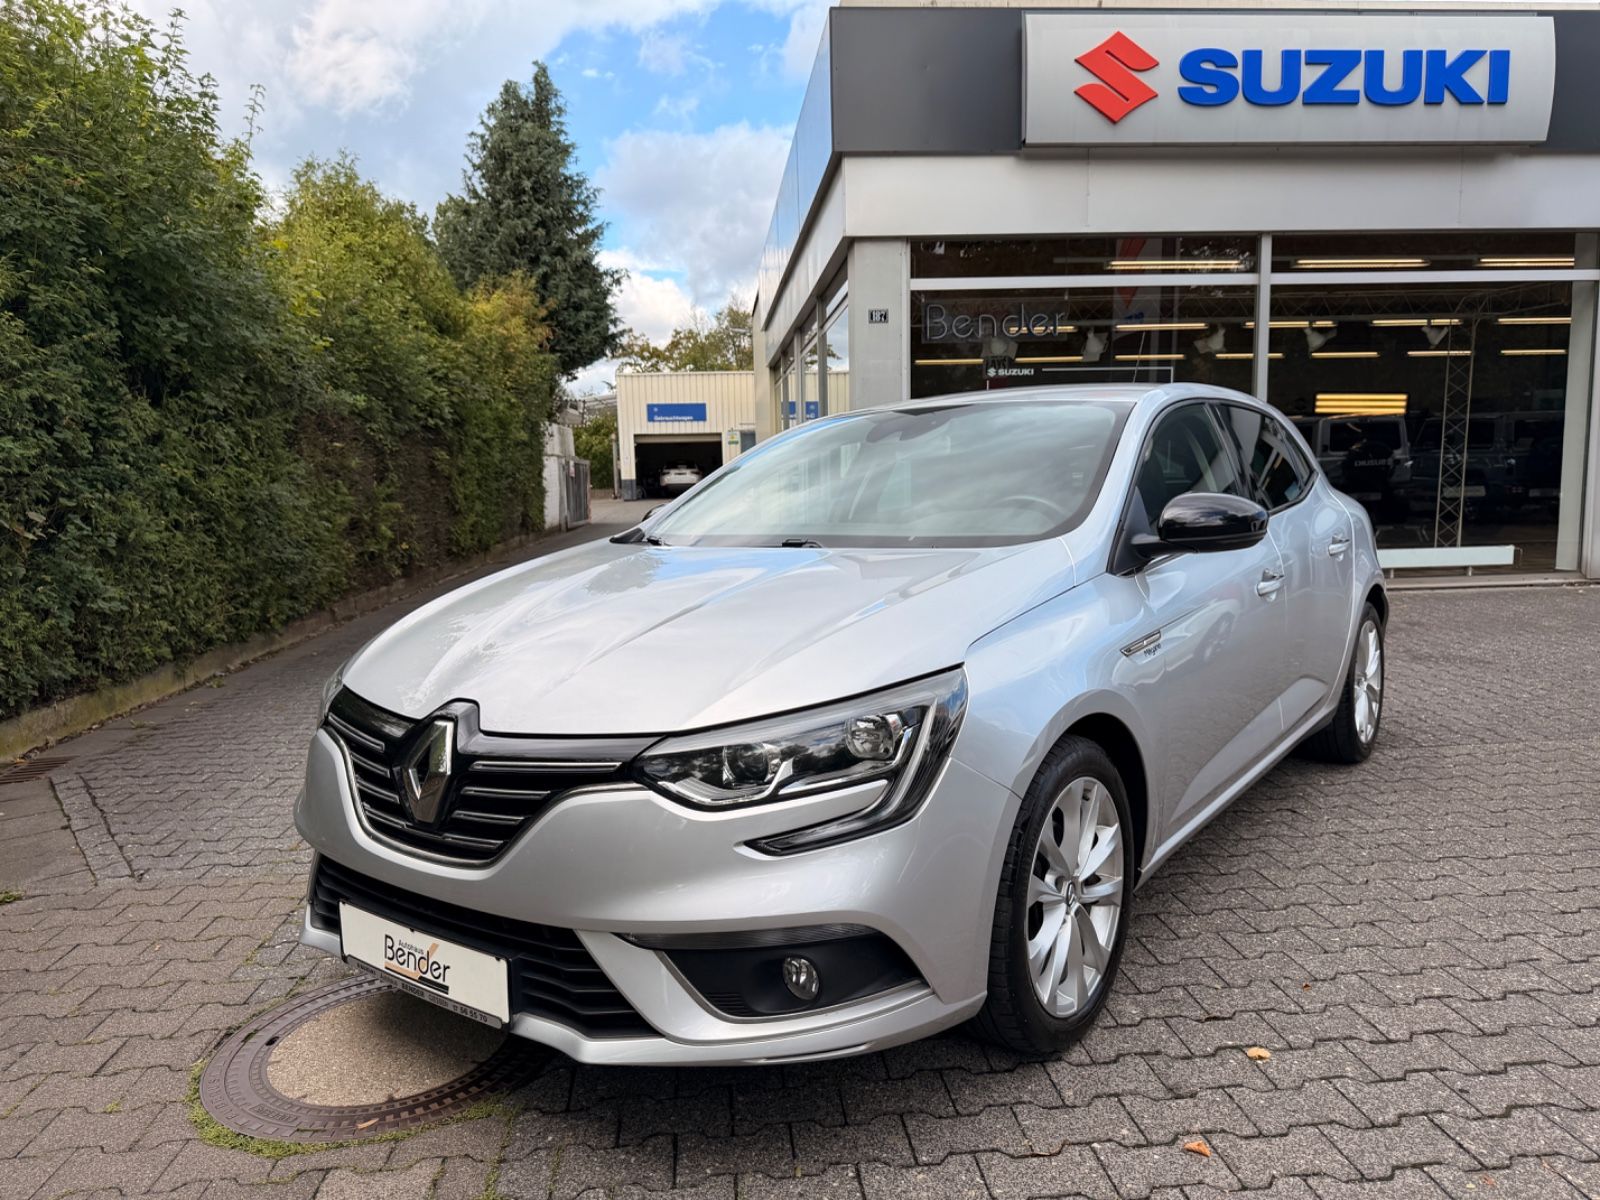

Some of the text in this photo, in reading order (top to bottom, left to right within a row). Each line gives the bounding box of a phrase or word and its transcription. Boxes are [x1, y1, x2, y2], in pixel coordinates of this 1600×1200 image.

[1178, 48, 1511, 107] SUZUKI
[926, 304, 1065, 340] Bender
[998, 368, 1034, 376] SUZUKI
[384, 934, 450, 982] Bender
